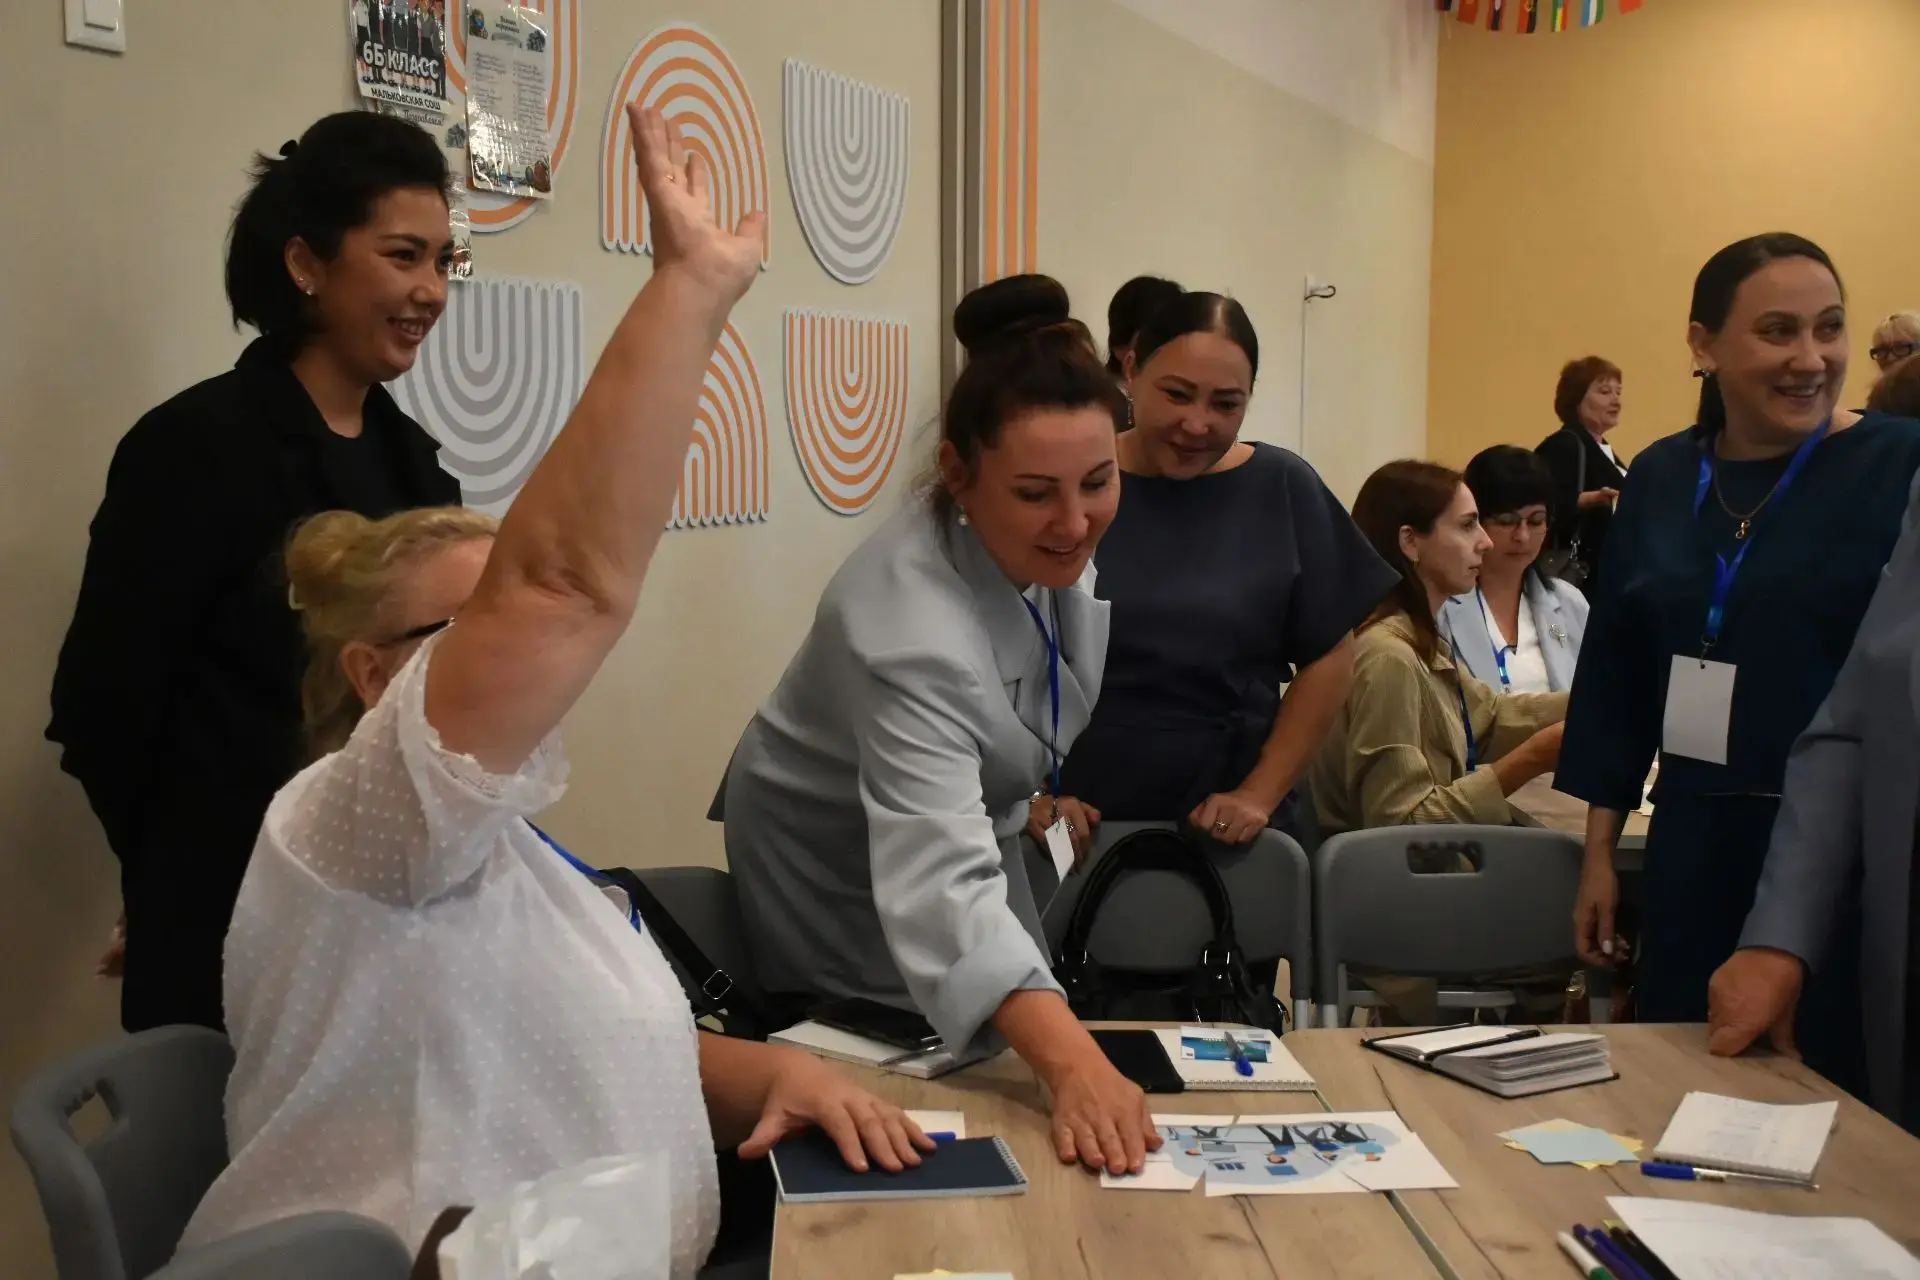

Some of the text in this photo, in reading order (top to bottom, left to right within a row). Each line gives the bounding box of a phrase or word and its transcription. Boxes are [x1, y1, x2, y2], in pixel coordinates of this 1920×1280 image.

[363, 41, 385, 66] 6Б
[387, 49, 440, 80] КЛАСС
[371, 87, 441, 110] МАЛЬКОВСКАЯ СОШ
